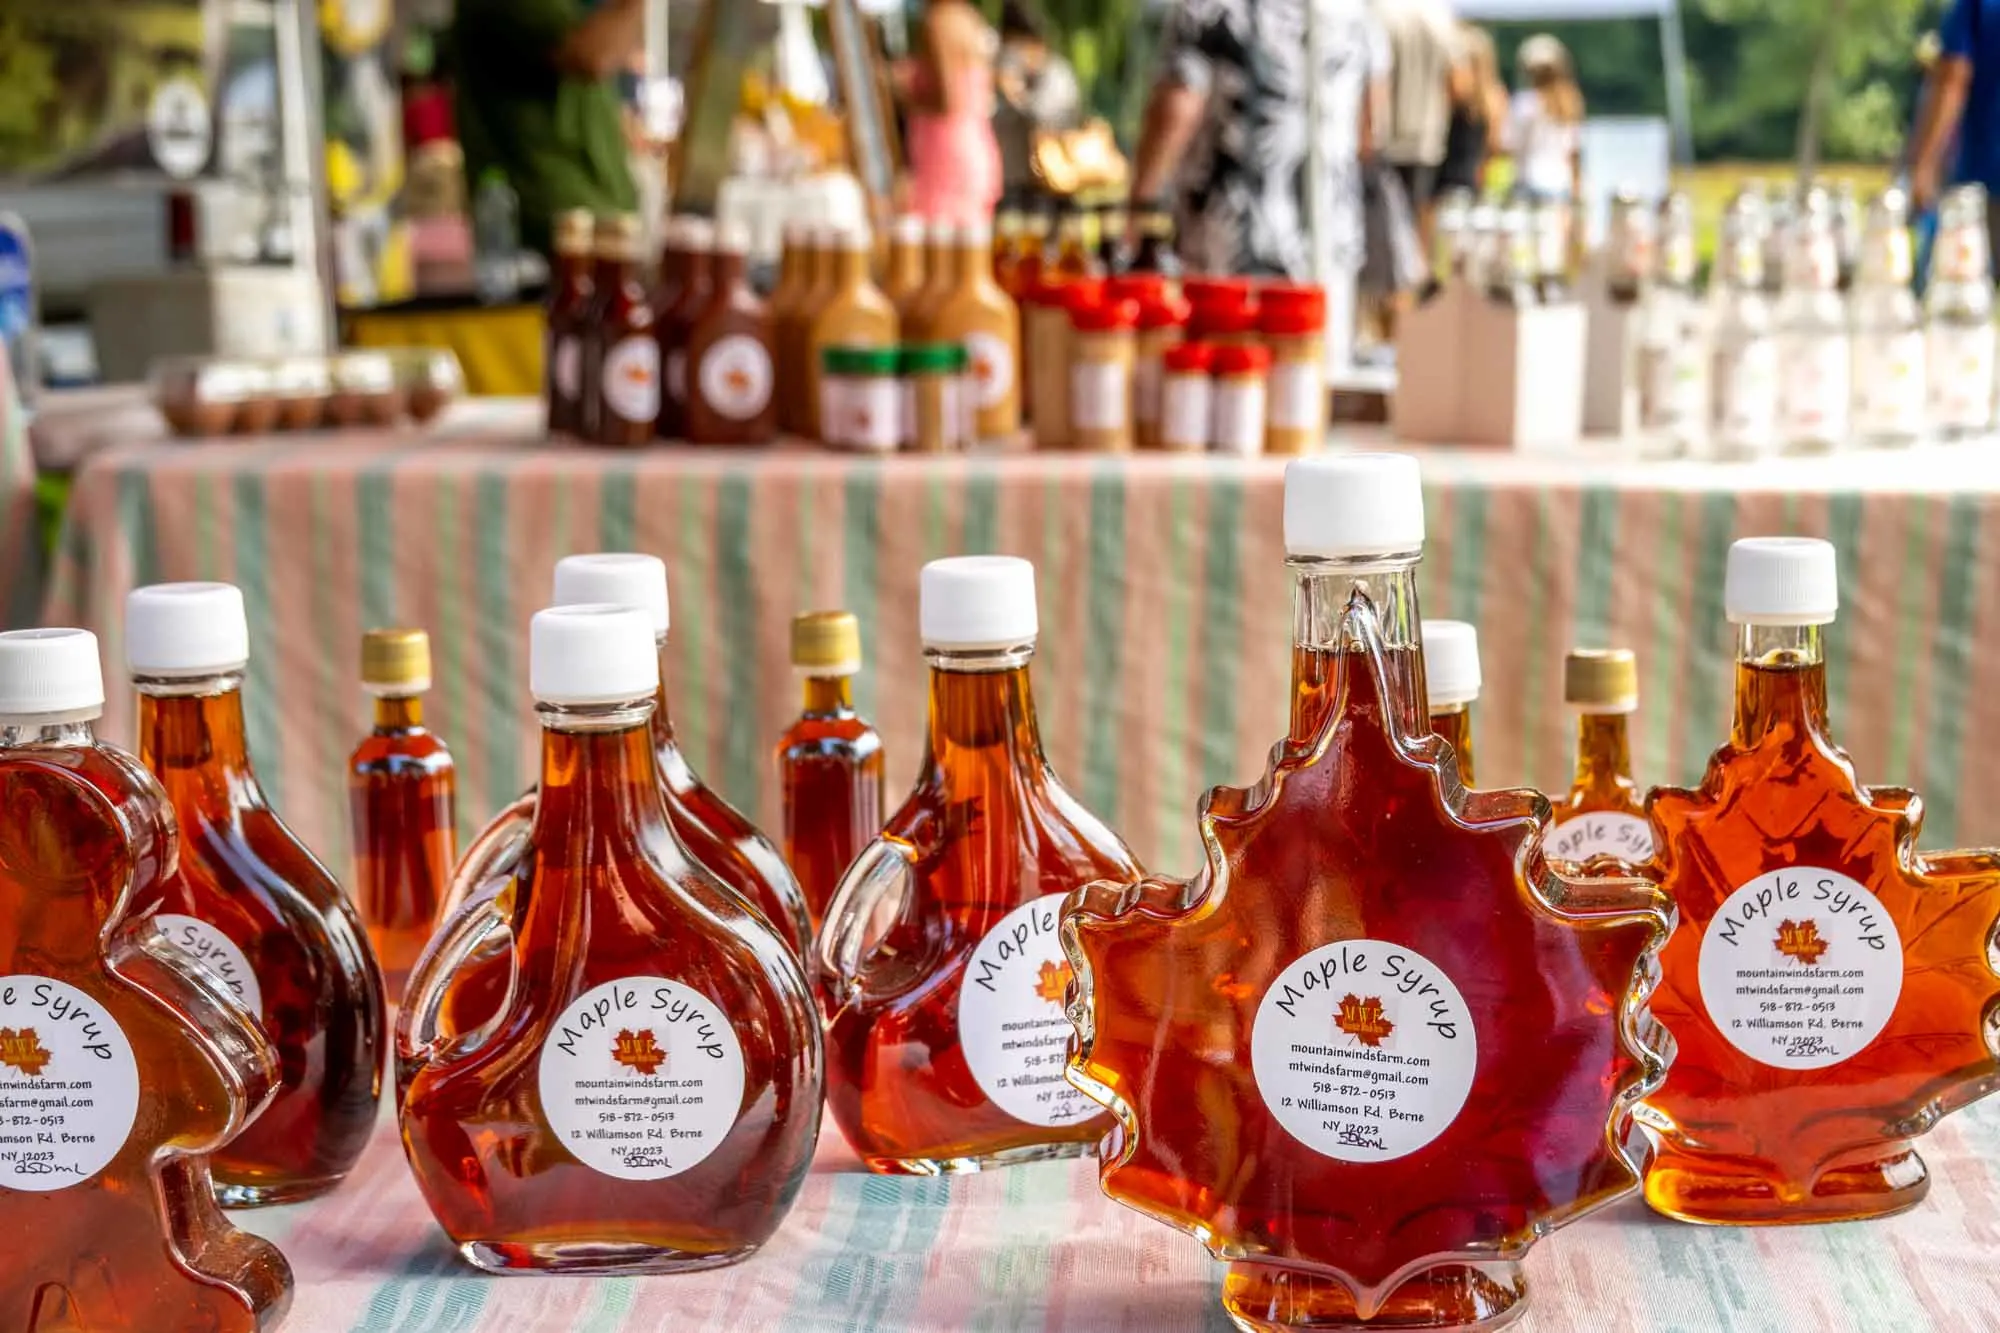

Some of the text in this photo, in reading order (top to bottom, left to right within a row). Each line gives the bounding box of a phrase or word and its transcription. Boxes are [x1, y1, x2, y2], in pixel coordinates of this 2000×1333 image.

[1557, 821, 1606, 853] aple
[1719, 876, 1885, 950] Maple Syrup
[975, 908, 1055, 992] Maple
[181, 926, 244, 995] Syrup
[1736, 968, 1864, 978] mountainwindsfarm.com
[1275, 946, 1457, 1039] Maple Syrup
[1736, 984, 1864, 999] mtwindsfarm@gmail.com
[1759, 1002, 1836, 1013] 518-872-0513
[31, 984, 113, 1060] Syrup
[557, 986, 724, 1059] Maple Syrup
[1731, 1020, 1742, 1029] 12
[1746, 1018, 1803, 1029] Williamson
[1831, 1019, 1864, 1029] Berne
[1771, 1035, 1824, 1046] NY 12023
[1290, 1043, 1430, 1067] mountainwindsfarm.com
[1288, 1061, 1429, 1086] mtwindsfarm@gmail.com
[575, 1077, 703, 1089] mountainwindsfarm.com
[996, 1078, 1008, 1089] 12
[1312, 1081, 1396, 1100] 518-872-0513
[574, 1094, 703, 1109] mtwindsfarm@gmail.com
[1036, 1090, 1052, 1103] NY
[599, 1112, 675, 1122] 518-872-0513
[1281, 1097, 1425, 1122] 12 Williamson Rd. Berne
[571, 1129, 582, 1139] 12
[586, 1128, 643, 1139] Williamson
[670, 1128, 703, 1138] Berne
[1322, 1120, 1379, 1136] NY 12023
[37, 1131, 57, 1144] Rd.
[60, 1132, 96, 1144] Berne
[1, 1151, 55, 1161] NY 12023
[611, 1146, 663, 1156] NY 12023
